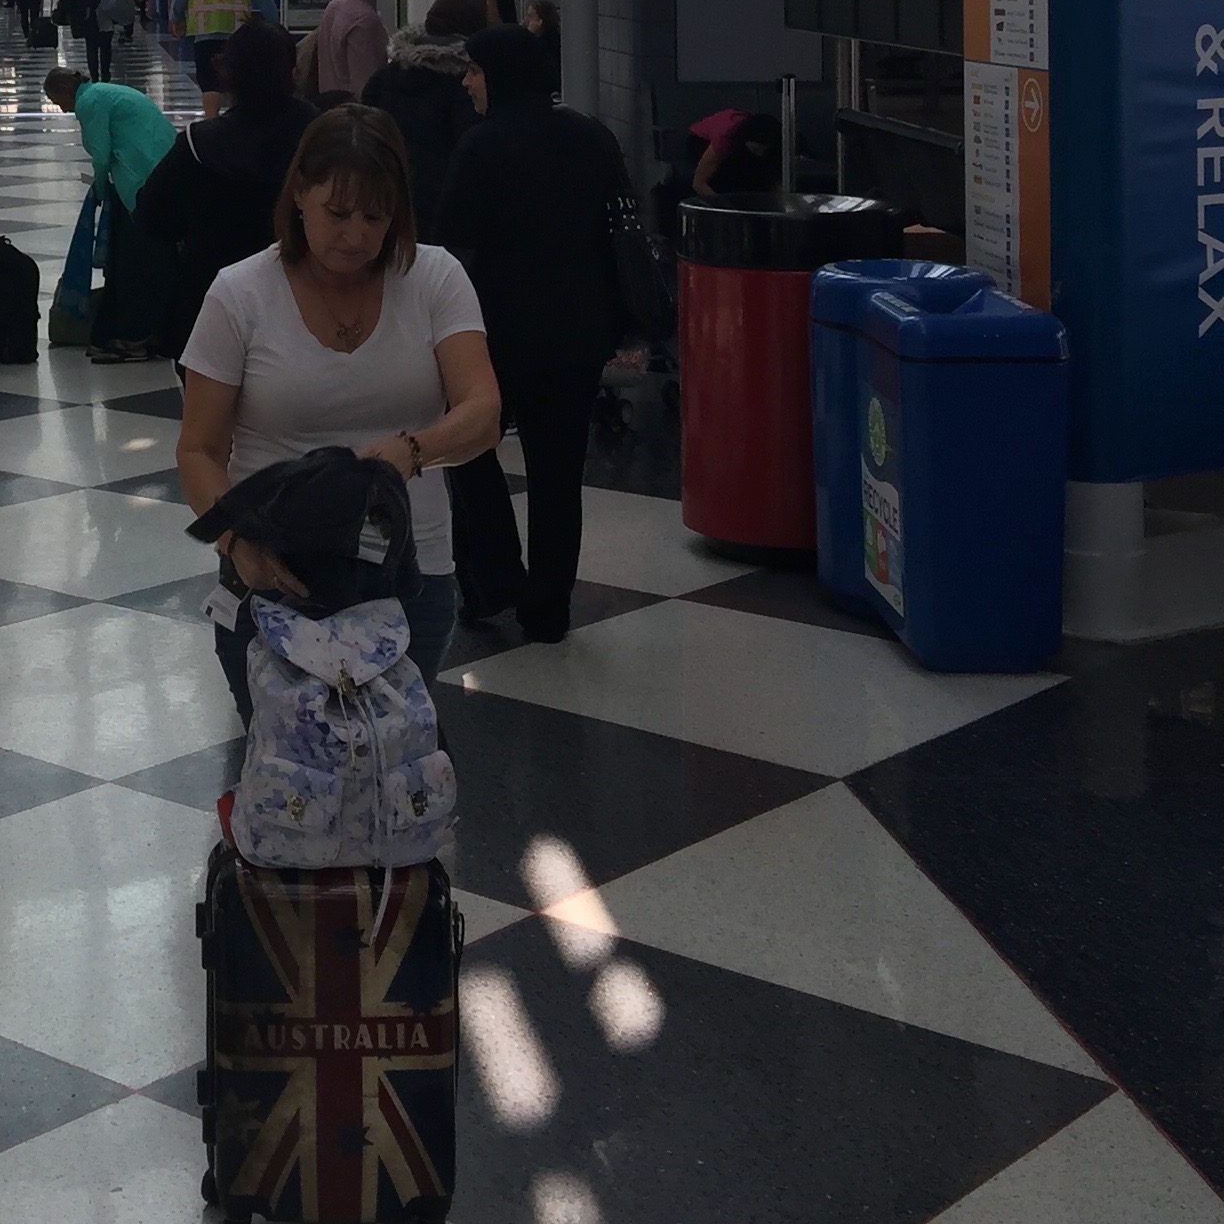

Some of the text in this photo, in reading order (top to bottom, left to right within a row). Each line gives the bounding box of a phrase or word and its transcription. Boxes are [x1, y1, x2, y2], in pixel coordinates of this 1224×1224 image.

[1195, 23, 1224, 76] &
[1197, 98, 1224, 338] RELAX
[863, 480, 899, 535] RECYCLE
[244, 1024, 429, 1051] AUSTRALIA
